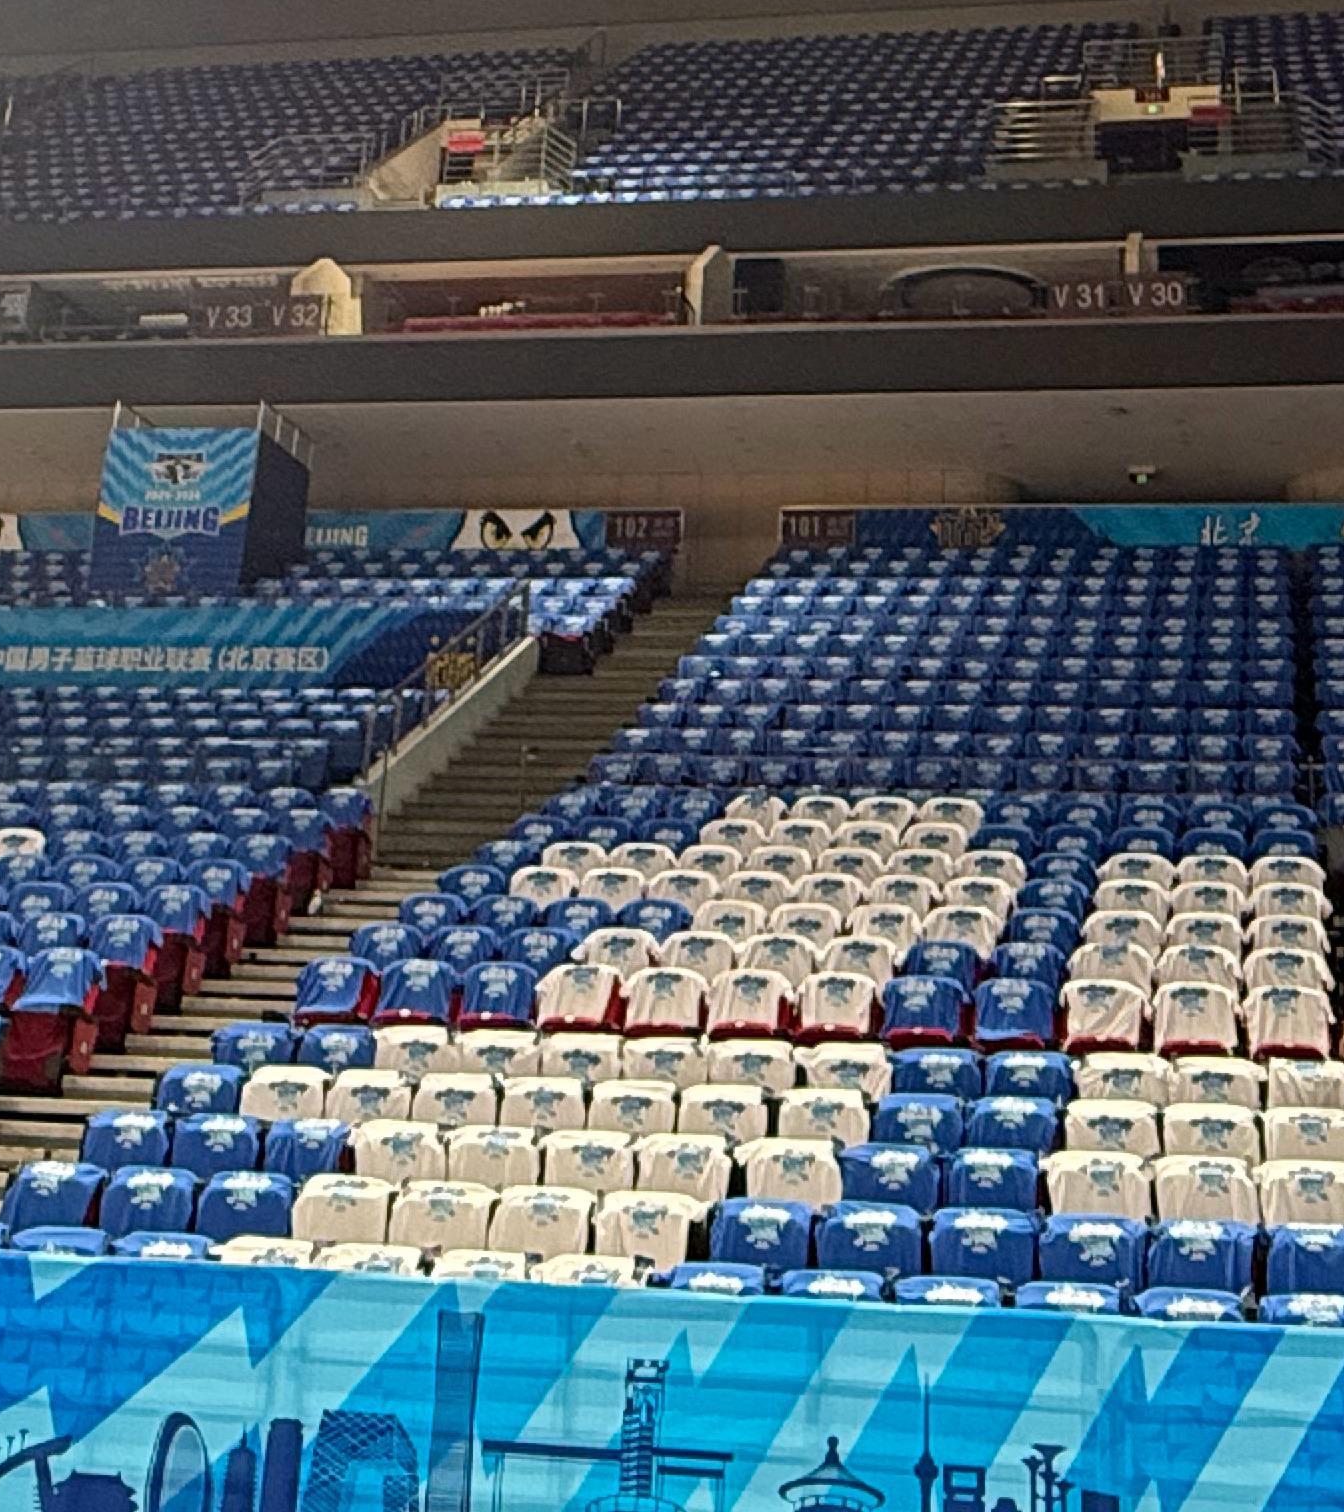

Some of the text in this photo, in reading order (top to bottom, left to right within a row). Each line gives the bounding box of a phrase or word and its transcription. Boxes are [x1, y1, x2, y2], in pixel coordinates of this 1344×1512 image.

[1055, 283, 1104, 308] V 31
[1126, 281, 1183, 306] V 30
[208, 304, 253, 329] V 33
[272, 302, 319, 327] V 32
[120, 504, 220, 536] BEIJING
[789, 514, 820, 537] 101
